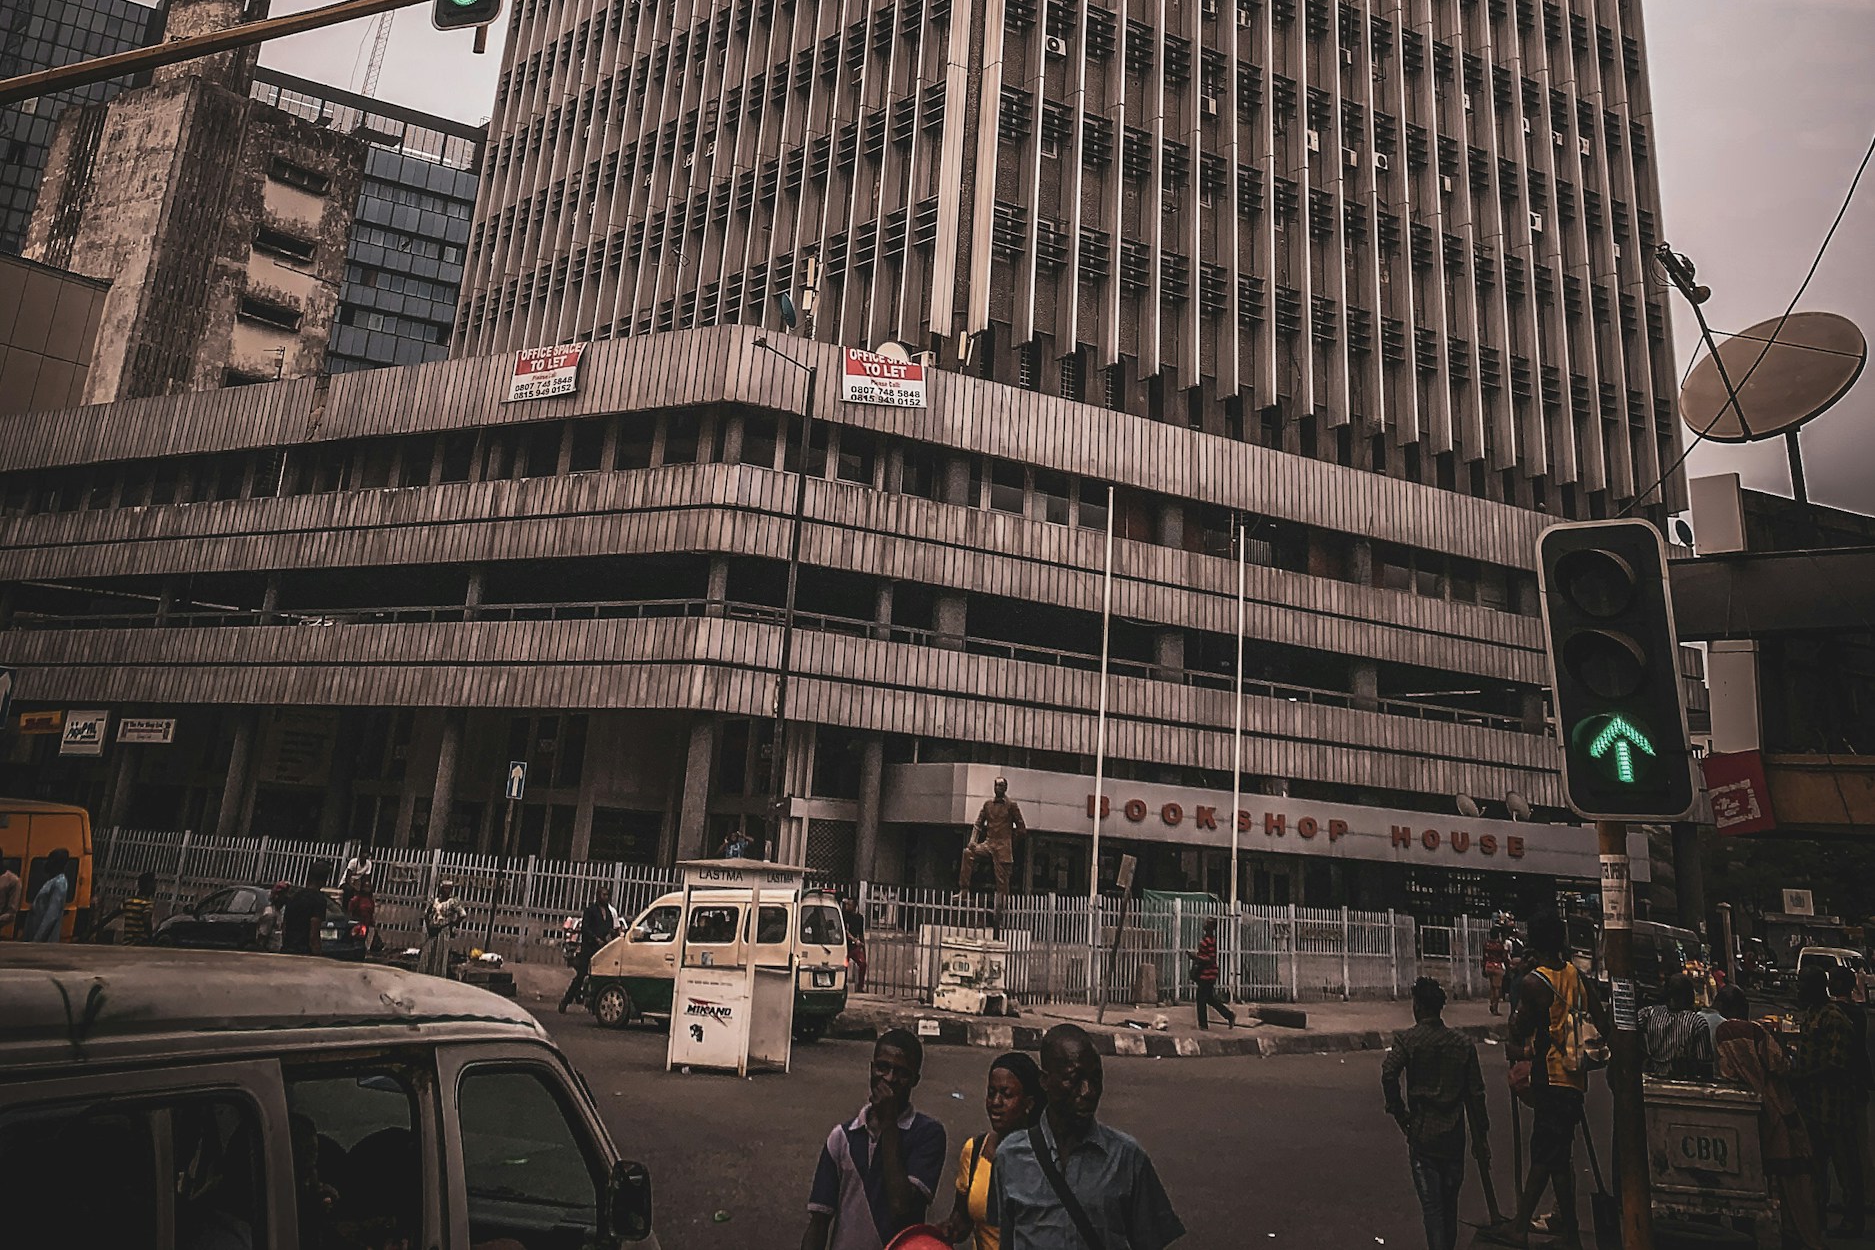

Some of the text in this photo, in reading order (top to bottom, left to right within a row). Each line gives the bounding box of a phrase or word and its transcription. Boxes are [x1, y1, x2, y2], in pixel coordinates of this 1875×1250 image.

[521, 342, 581, 361] OFFICE SPACE
[849, 348, 885, 364] OFFICE
[531, 355, 567, 371] TO LET
[863, 363, 907, 378] TO LET
[513, 391, 533, 400] 0815
[551, 384, 571, 393] 0152
[515, 383, 534, 392] 0807
[850, 386, 920, 398] 0807 748 5848
[850, 394, 875, 402] 0815
[897, 398, 921, 406] 0152
[1087, 794, 1524, 858] BOOKSHOP HOUSE
[699, 868, 744, 882] LASTMA
[766, 873, 794, 883] LASTMA
[686, 1005, 732, 1016] MIKANO
